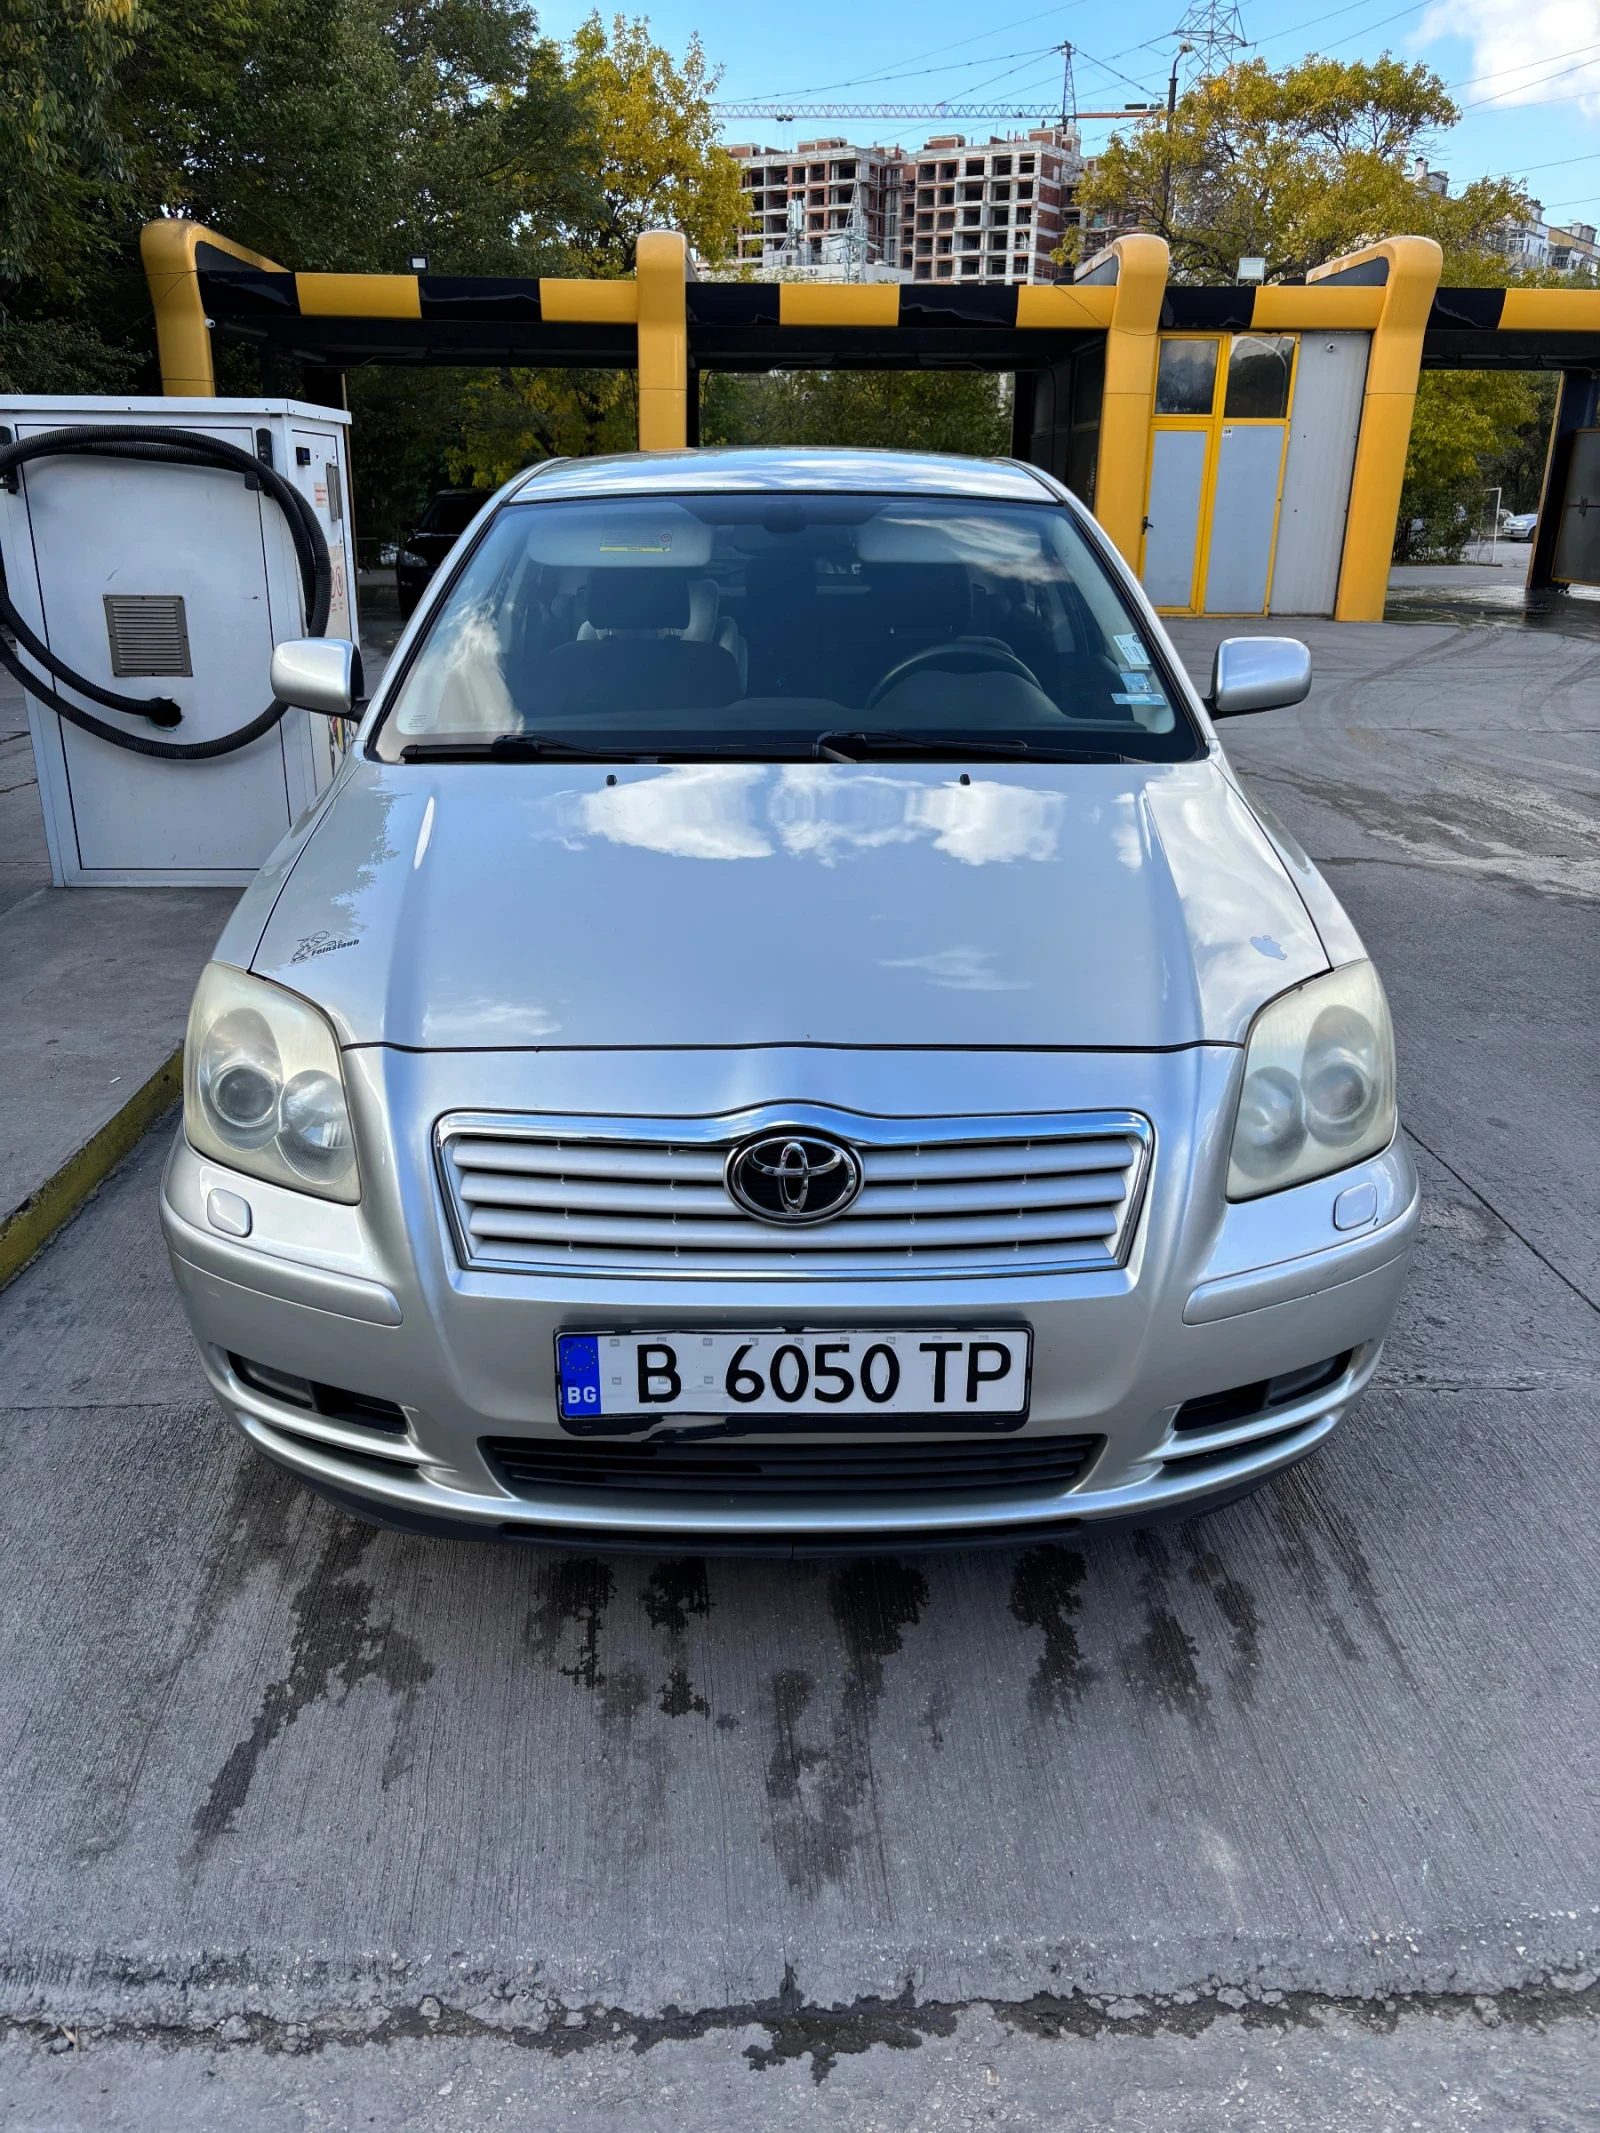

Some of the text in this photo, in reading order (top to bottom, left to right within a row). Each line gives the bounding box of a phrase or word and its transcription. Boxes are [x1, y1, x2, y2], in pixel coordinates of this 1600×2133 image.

[637, 1342, 1012, 1403] B 6050 TP
[567, 1386, 597, 1404] BG
